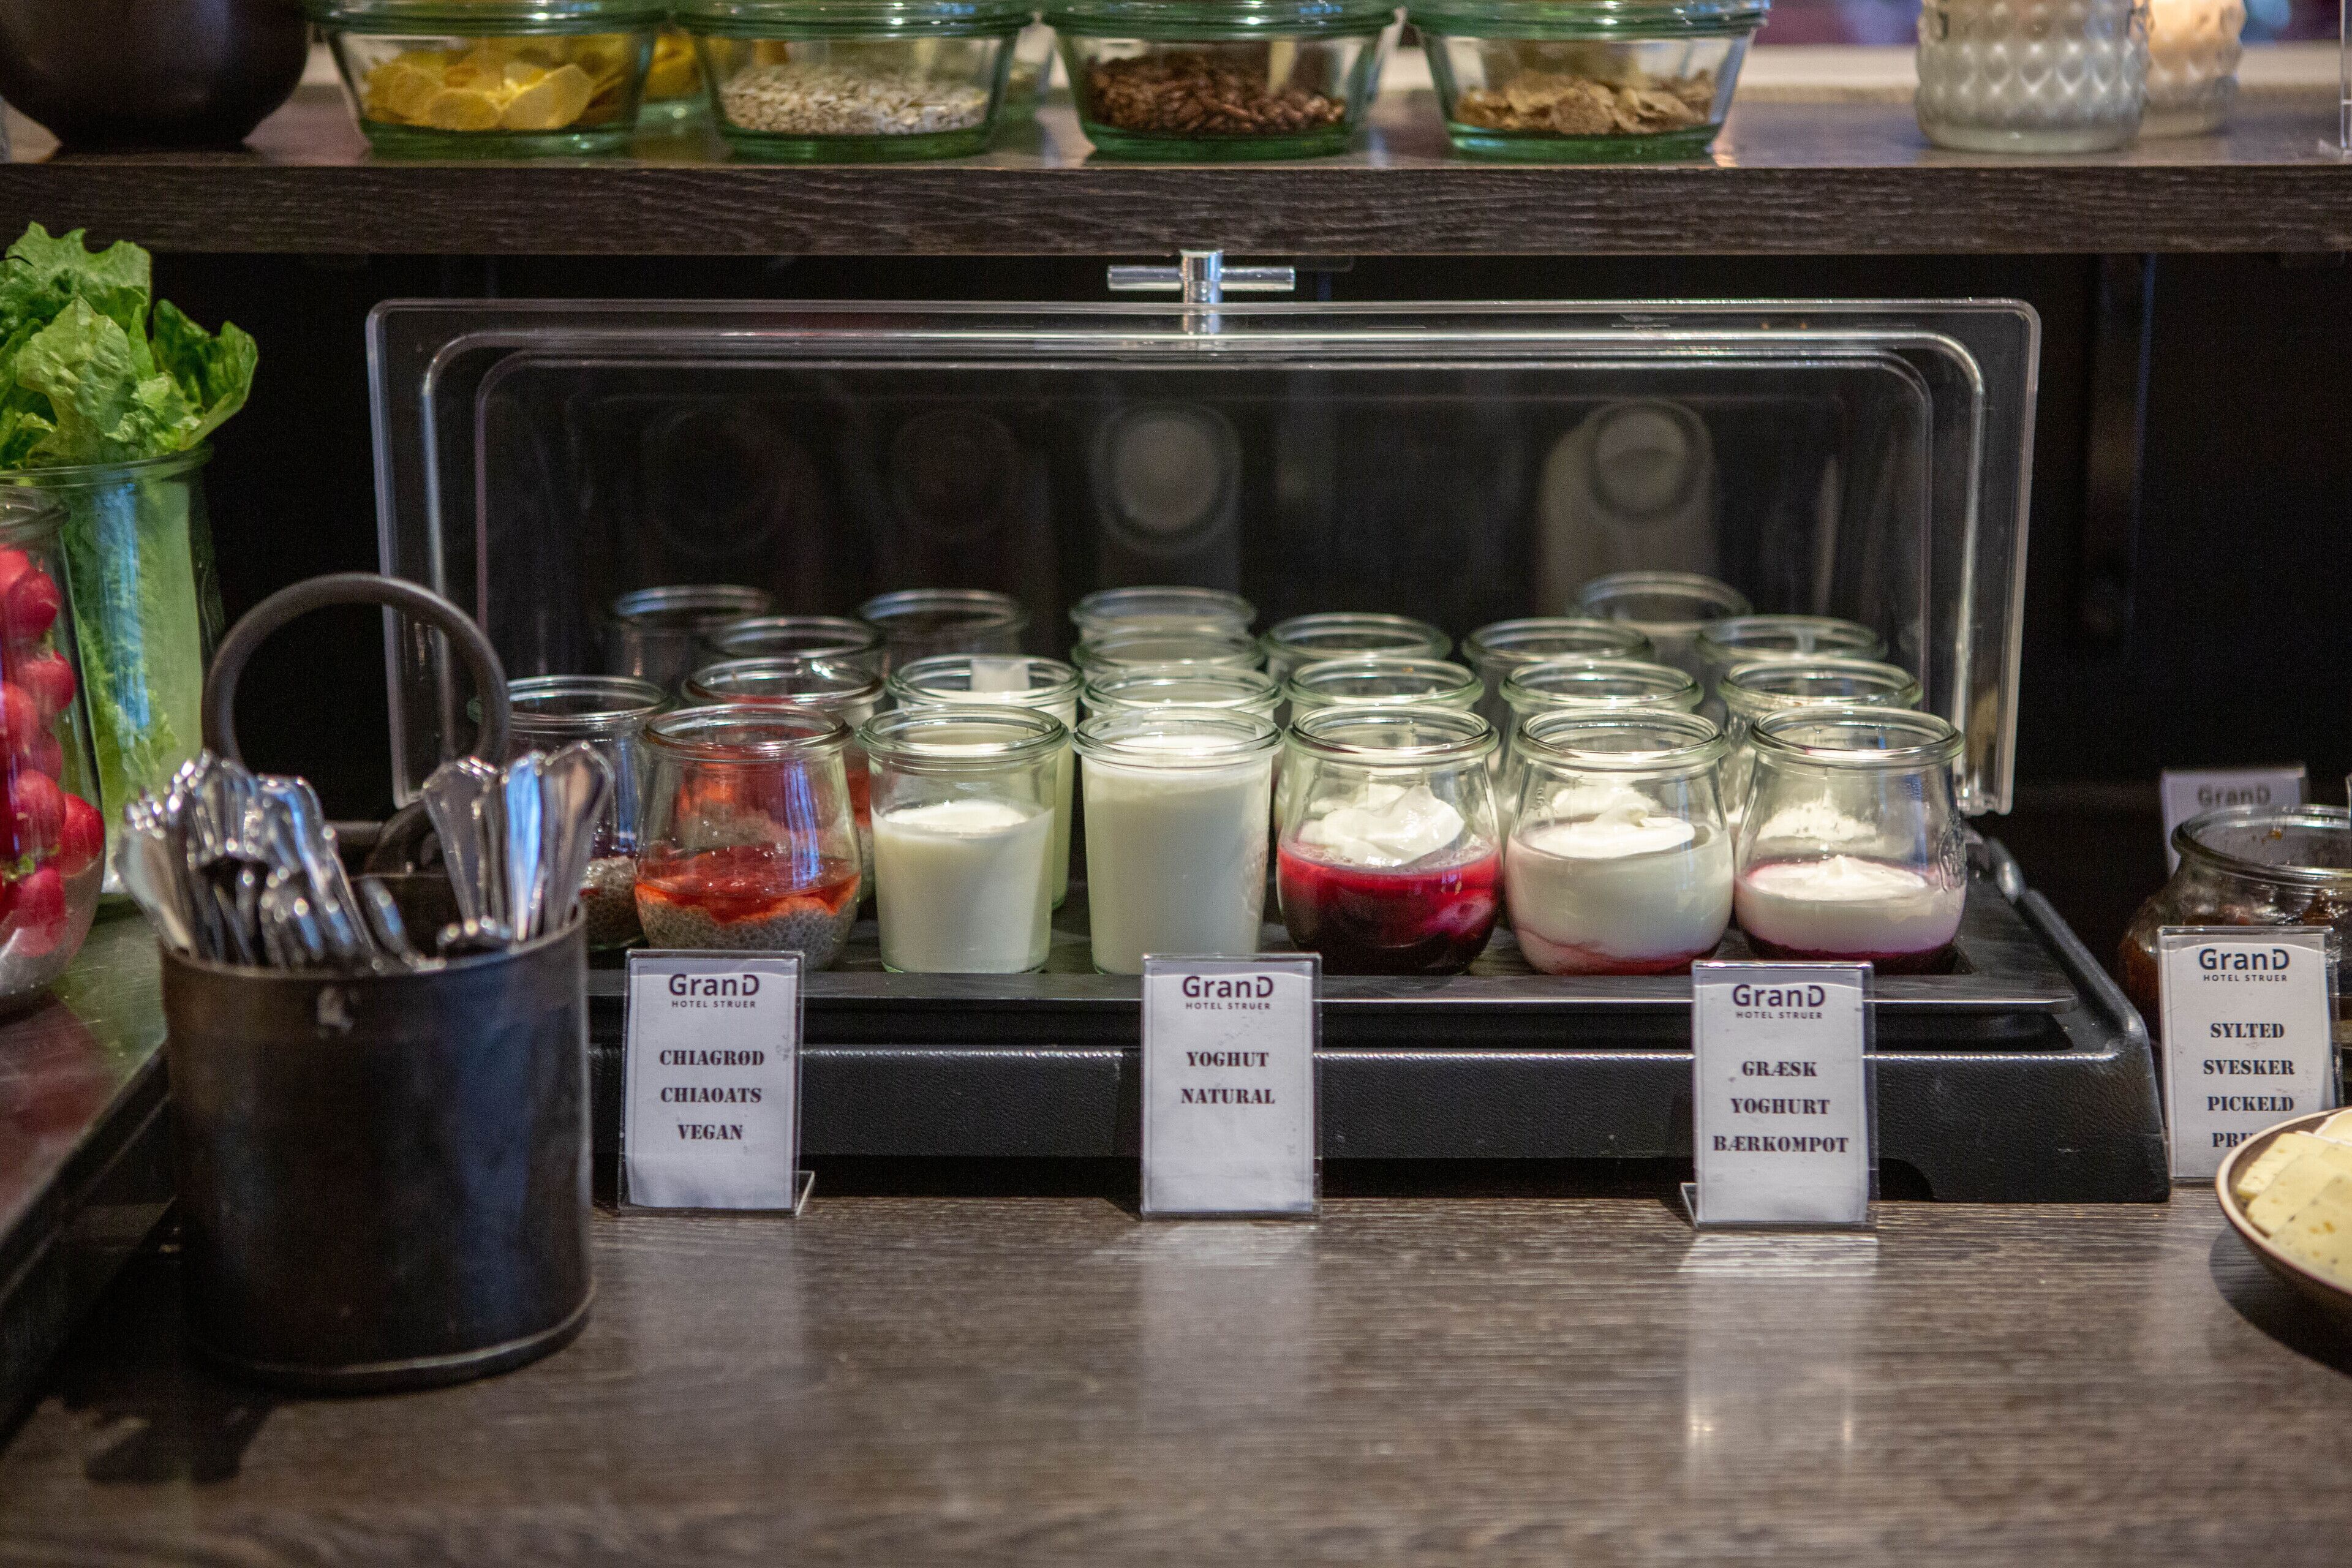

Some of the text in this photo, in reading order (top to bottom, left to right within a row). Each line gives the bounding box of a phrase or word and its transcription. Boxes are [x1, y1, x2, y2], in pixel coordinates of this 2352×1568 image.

[1185, 1002, 1223, 1011] HOTEL
[1736, 1011, 1823, 1020] HOTEL STRUER
[2211, 1023, 2284, 1038] SYLTED
[1186, 1052, 1268, 1066] YOGHUT
[1743, 1061, 1817, 1076] GRÆSK
[2204, 1060, 2295, 1075] SVESKER
[660, 1088, 762, 1102] CHIAOATS
[1181, 1089, 1275, 1104] NATURAL
[1731, 1098, 1830, 1114] YOGHURT
[2207, 1096, 2293, 1111] PICKELD
[678, 1125, 743, 1140] VEGAN
[1714, 1136, 1849, 1152] BÆRKOMPOT
